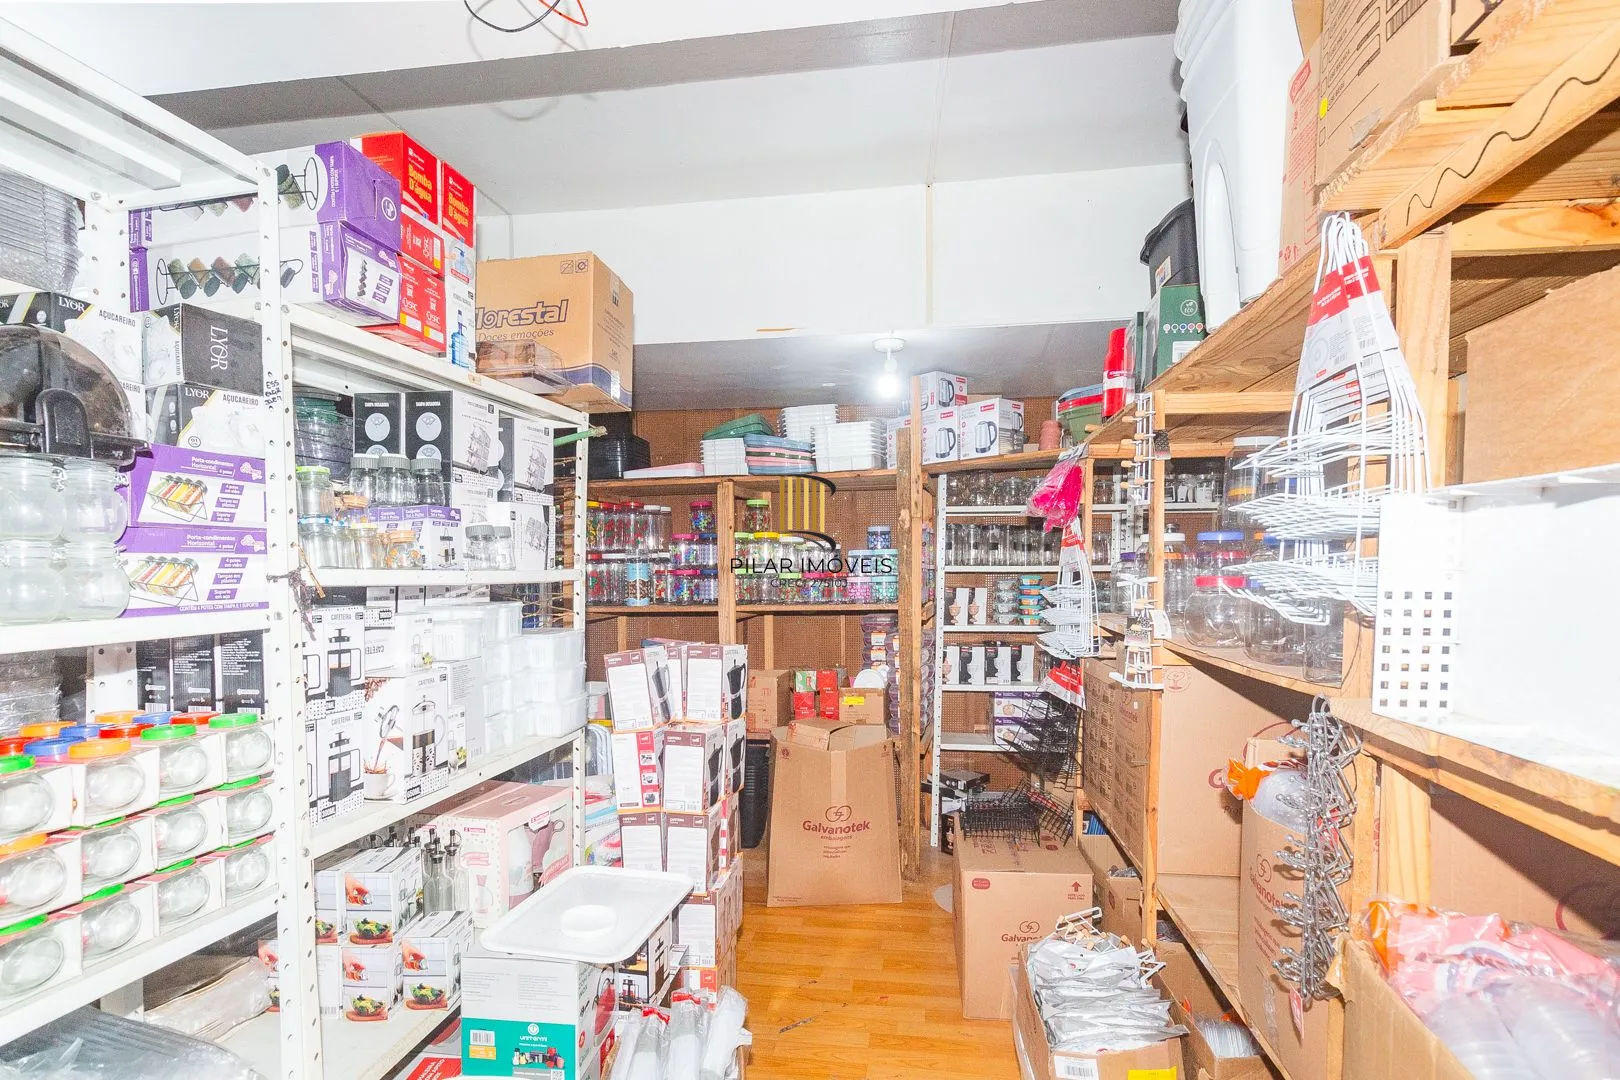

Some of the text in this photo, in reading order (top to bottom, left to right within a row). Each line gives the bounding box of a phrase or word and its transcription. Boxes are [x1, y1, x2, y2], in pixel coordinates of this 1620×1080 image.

[409, 163, 433, 190] Bomba
[448, 191, 469, 216] Bomba
[58, 296, 85, 312] LYOR
[99, 309, 136, 327] AÇUCAREIRO
[475, 299, 569, 330] lorestal
[511, 329, 554, 340] emoções
[210, 325, 229, 370] LYOR
[120, 381, 141, 393] CAREIRO
[184, 387, 210, 400] LYOR
[222, 393, 259, 406] AÇUCAREIRO
[802, 820, 871, 835] Galvanotek
